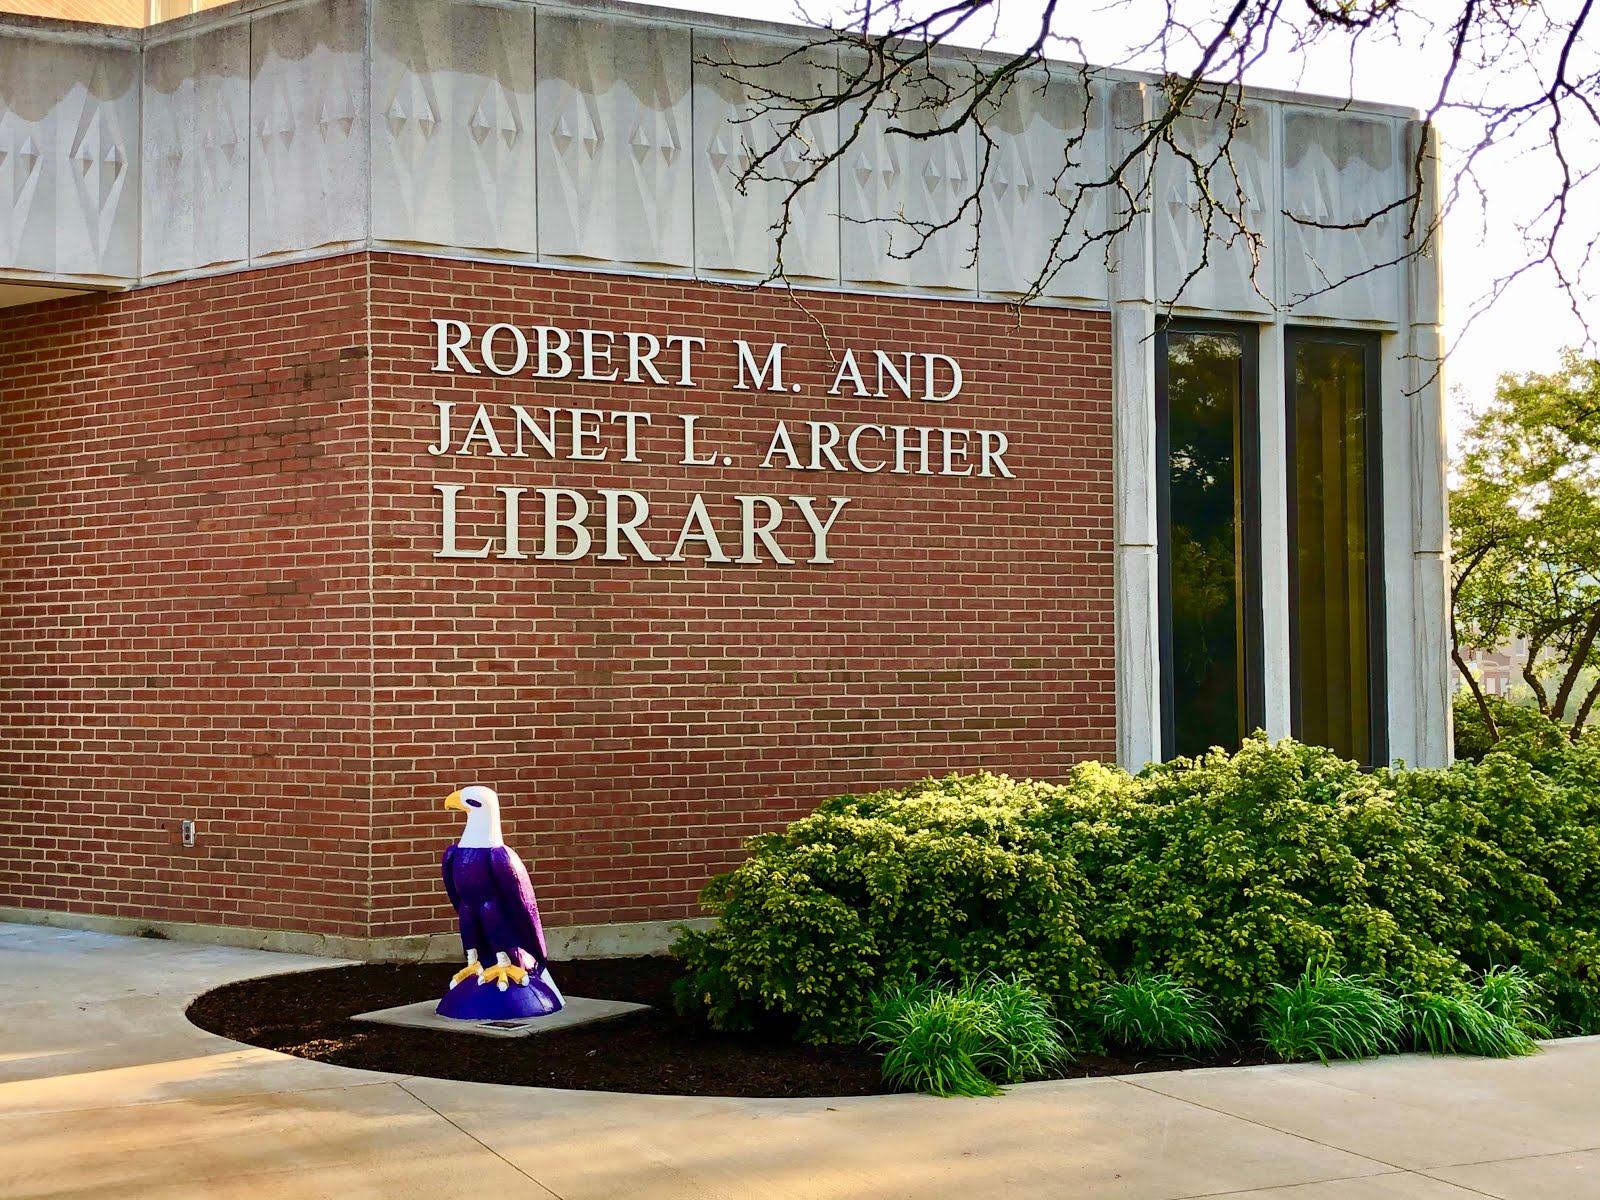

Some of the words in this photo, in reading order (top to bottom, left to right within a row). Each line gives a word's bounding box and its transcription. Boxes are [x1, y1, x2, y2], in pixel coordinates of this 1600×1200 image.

[430, 318, 706, 387] ROBERT
[732, 339, 801, 393] M.
[827, 347, 964, 401] AND
[427, 402, 652, 463] JANET
[678, 414, 733, 467] L.
[760, 419, 1016, 479] ARCHER
[432, 484, 851, 565] LIBRARY
